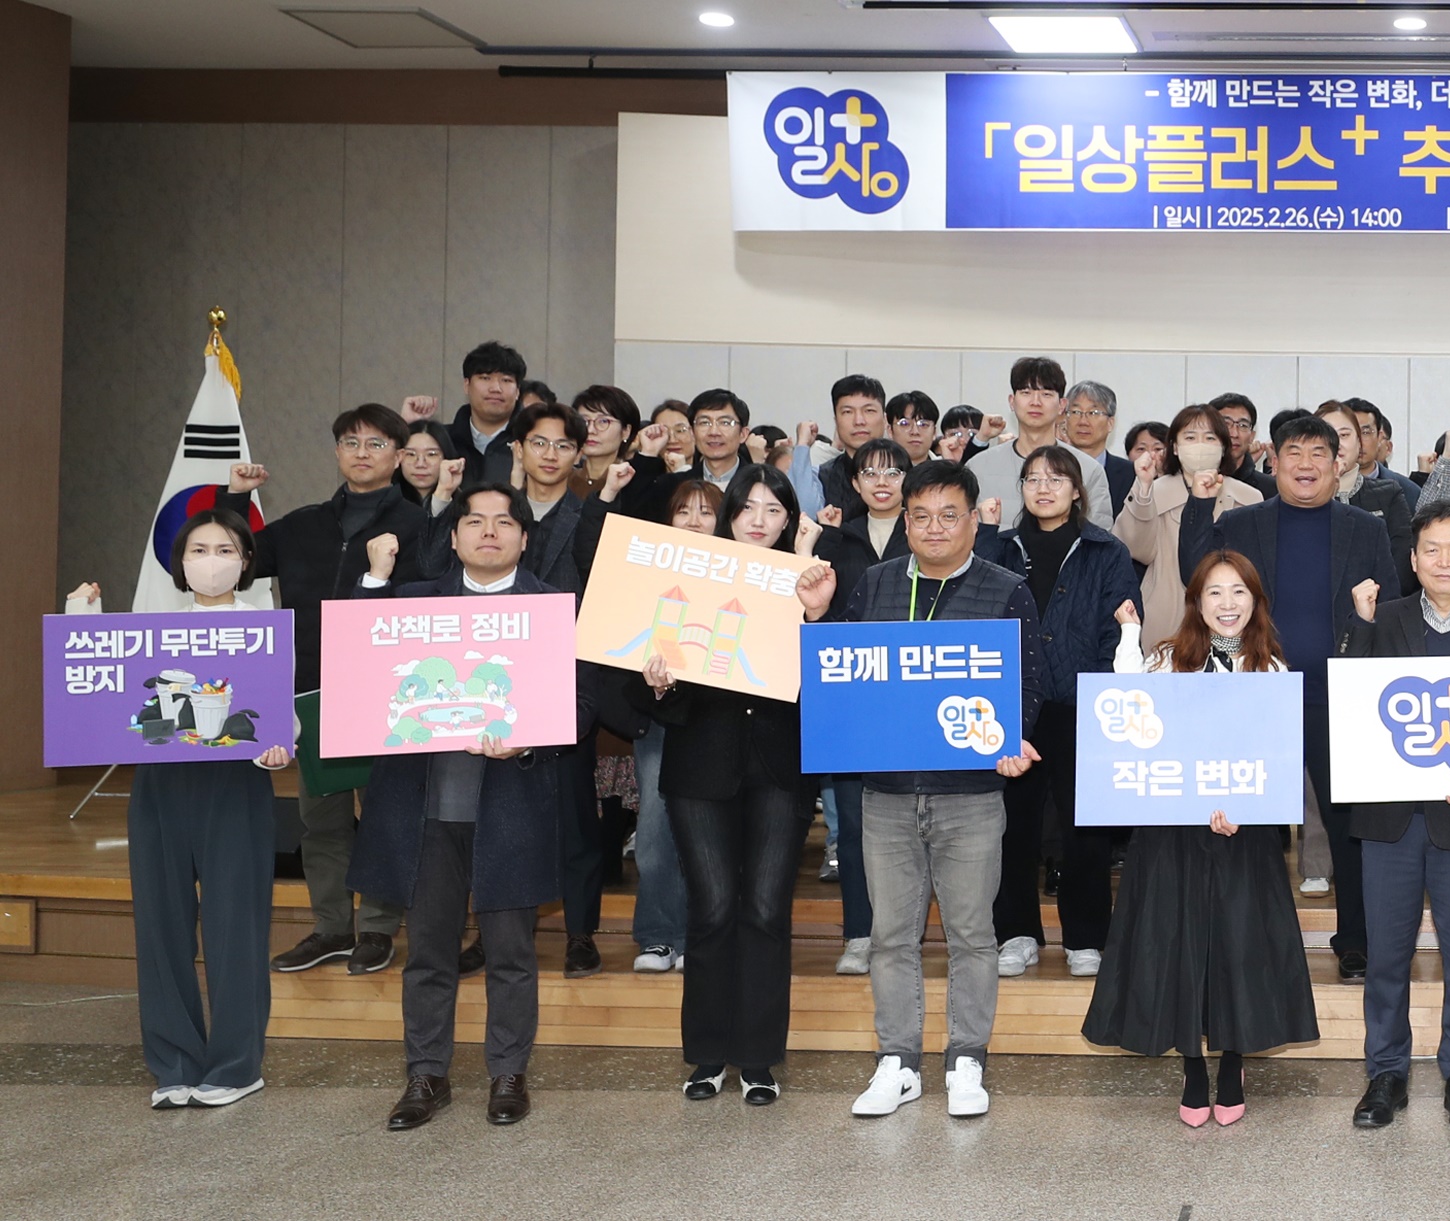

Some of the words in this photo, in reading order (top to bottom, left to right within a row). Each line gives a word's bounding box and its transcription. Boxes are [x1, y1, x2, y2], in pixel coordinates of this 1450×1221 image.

[1167, 78, 1217, 108] 함께
[1225, 79, 1300, 108] 만드는
[1307, 79, 1359, 108] 작은
[1366, 79, 1423, 110] 변화,
[1217, 206, 1345, 229] 2025.2.26.(수)
[1351, 208, 1402, 227] 14:00
[625, 535, 739, 584] 놀이공간
[744, 561, 800, 597] 확충
[64, 629, 153, 660] 쓰레기
[160, 626, 274, 657] 무단투기
[370, 615, 462, 646] 산책로
[471, 612, 531, 641] 정비
[65, 665, 125, 695] 방지
[818, 646, 888, 683] 함께
[899, 644, 1004, 681] 만드는
[1112, 760, 1184, 796] 작은
[1195, 759, 1267, 796] 변화
